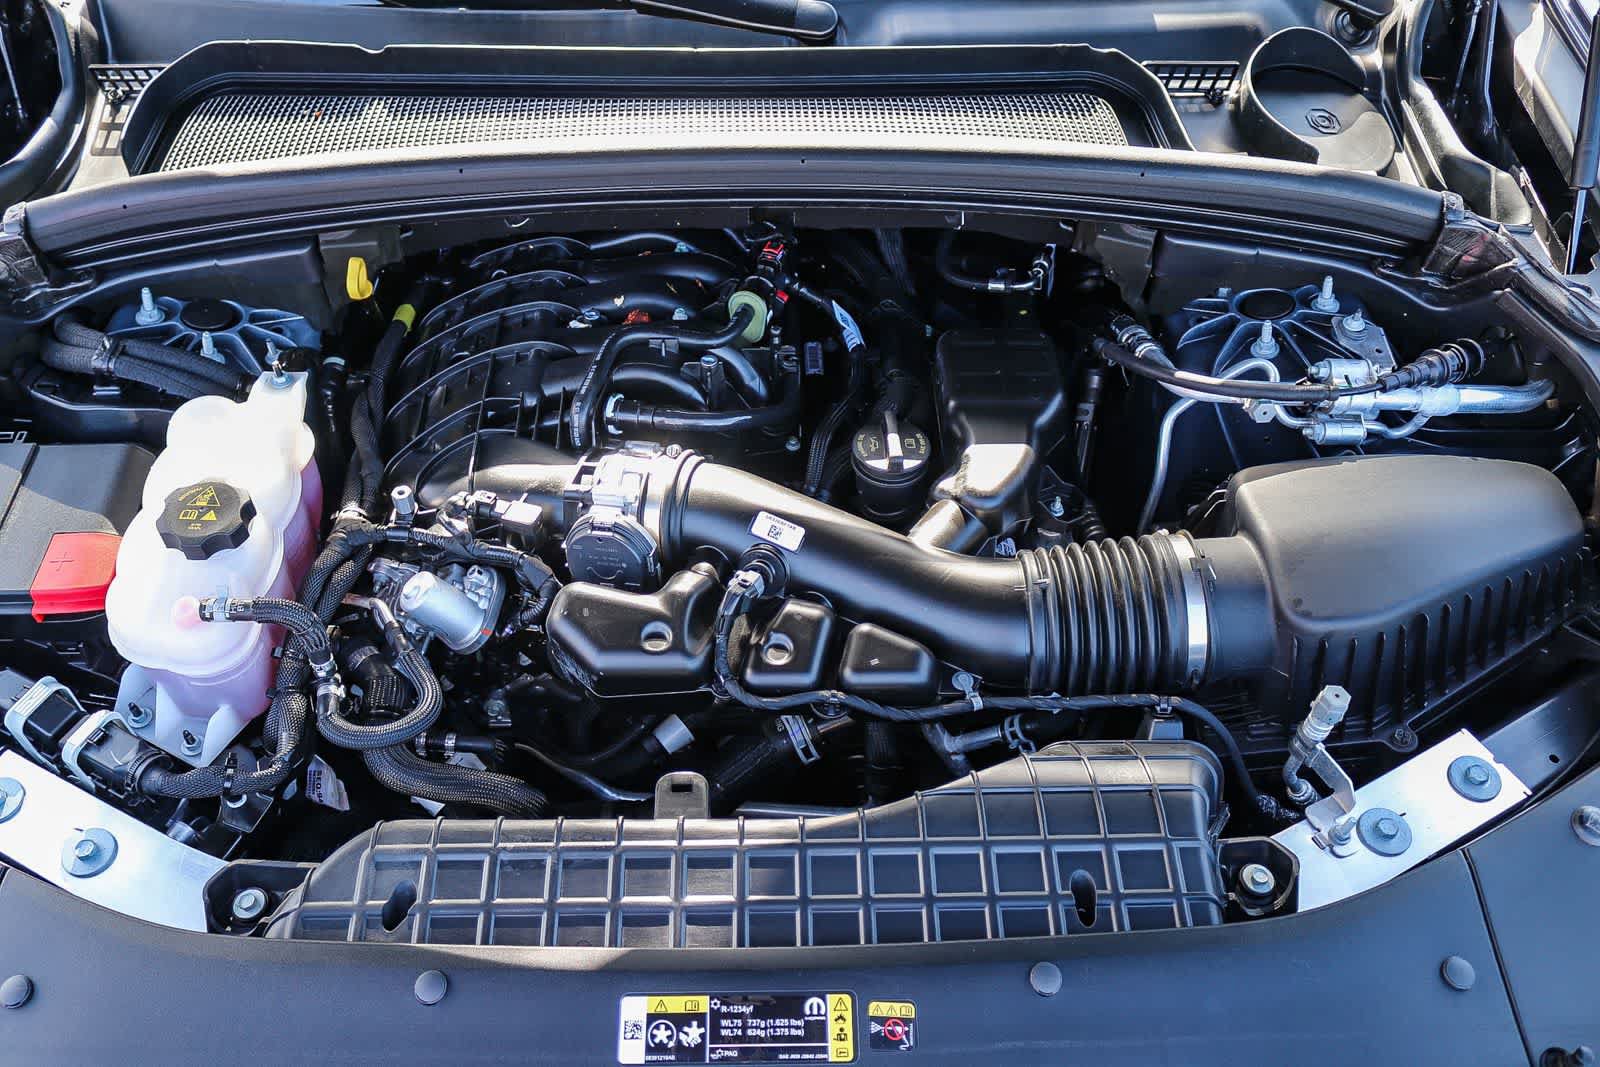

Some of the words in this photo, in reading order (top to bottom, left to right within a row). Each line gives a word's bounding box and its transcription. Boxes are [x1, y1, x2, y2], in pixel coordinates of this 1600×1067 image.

[720, 1005, 754, 1014] R-1234yf
[720, 1019, 742, 1027] WL75
[747, 1019, 766, 1028] 737g
[790, 1019, 805, 1028] lbs)
[790, 1028, 805, 1037] lbs)
